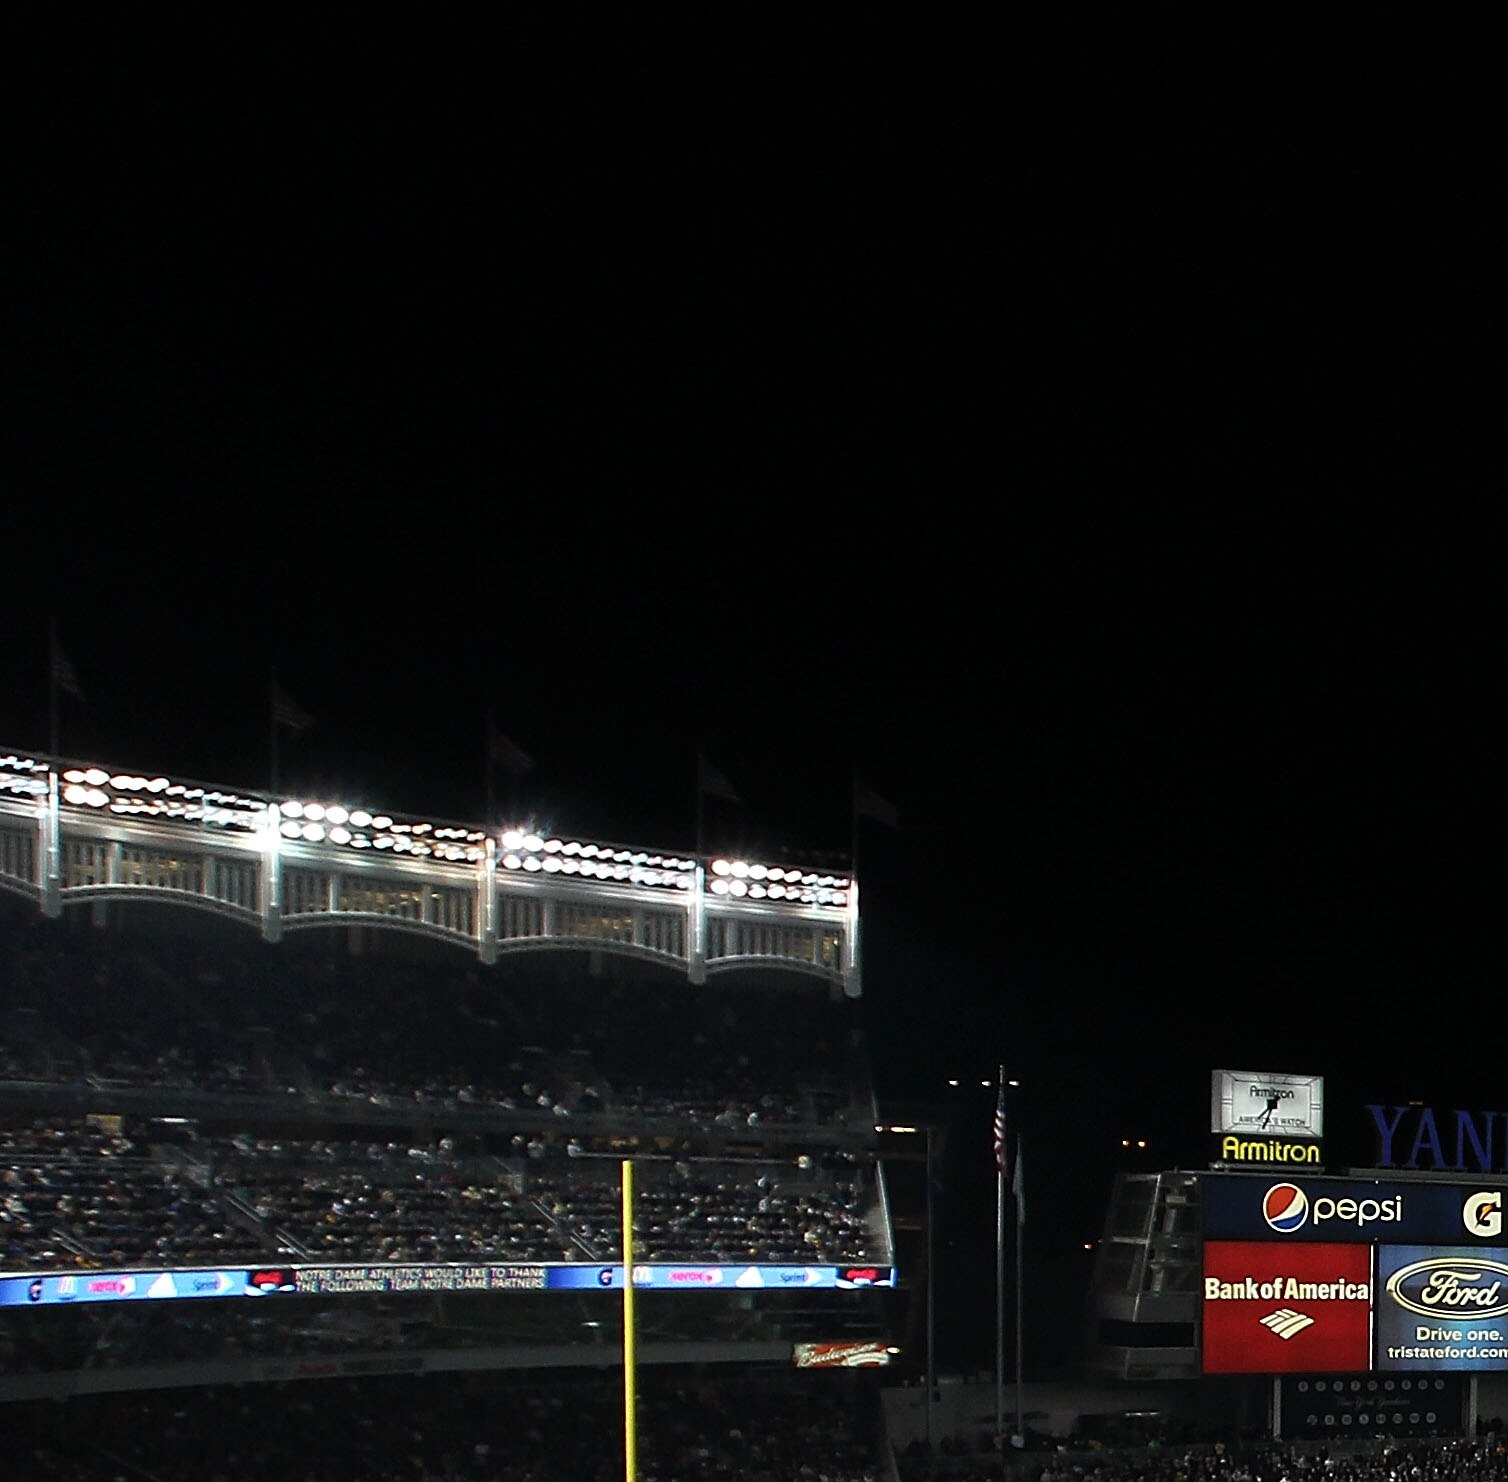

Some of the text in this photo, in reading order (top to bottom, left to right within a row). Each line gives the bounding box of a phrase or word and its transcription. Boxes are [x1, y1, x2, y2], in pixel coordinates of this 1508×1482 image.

[1223, 1136, 1319, 1162] Armitron
[1313, 1195, 1402, 1227] pepsi
[1463, 1192, 1501, 1237] G
[295, 1278, 544, 1292] THE FOLLOWING TEAM NOTRE DAME PARTNERS
[296, 1268, 545, 1281] NOTRE DAME ATHLETICS WOULD LIKE TO THANK
[780, 1272, 806, 1283] Sprint
[1205, 1277, 1369, 1300] Bank of America
[1420, 1268, 1499, 1308] Ford
[1416, 1327, 1503, 1341] Drive one.
[801, 1343, 878, 1364] Budweiser
